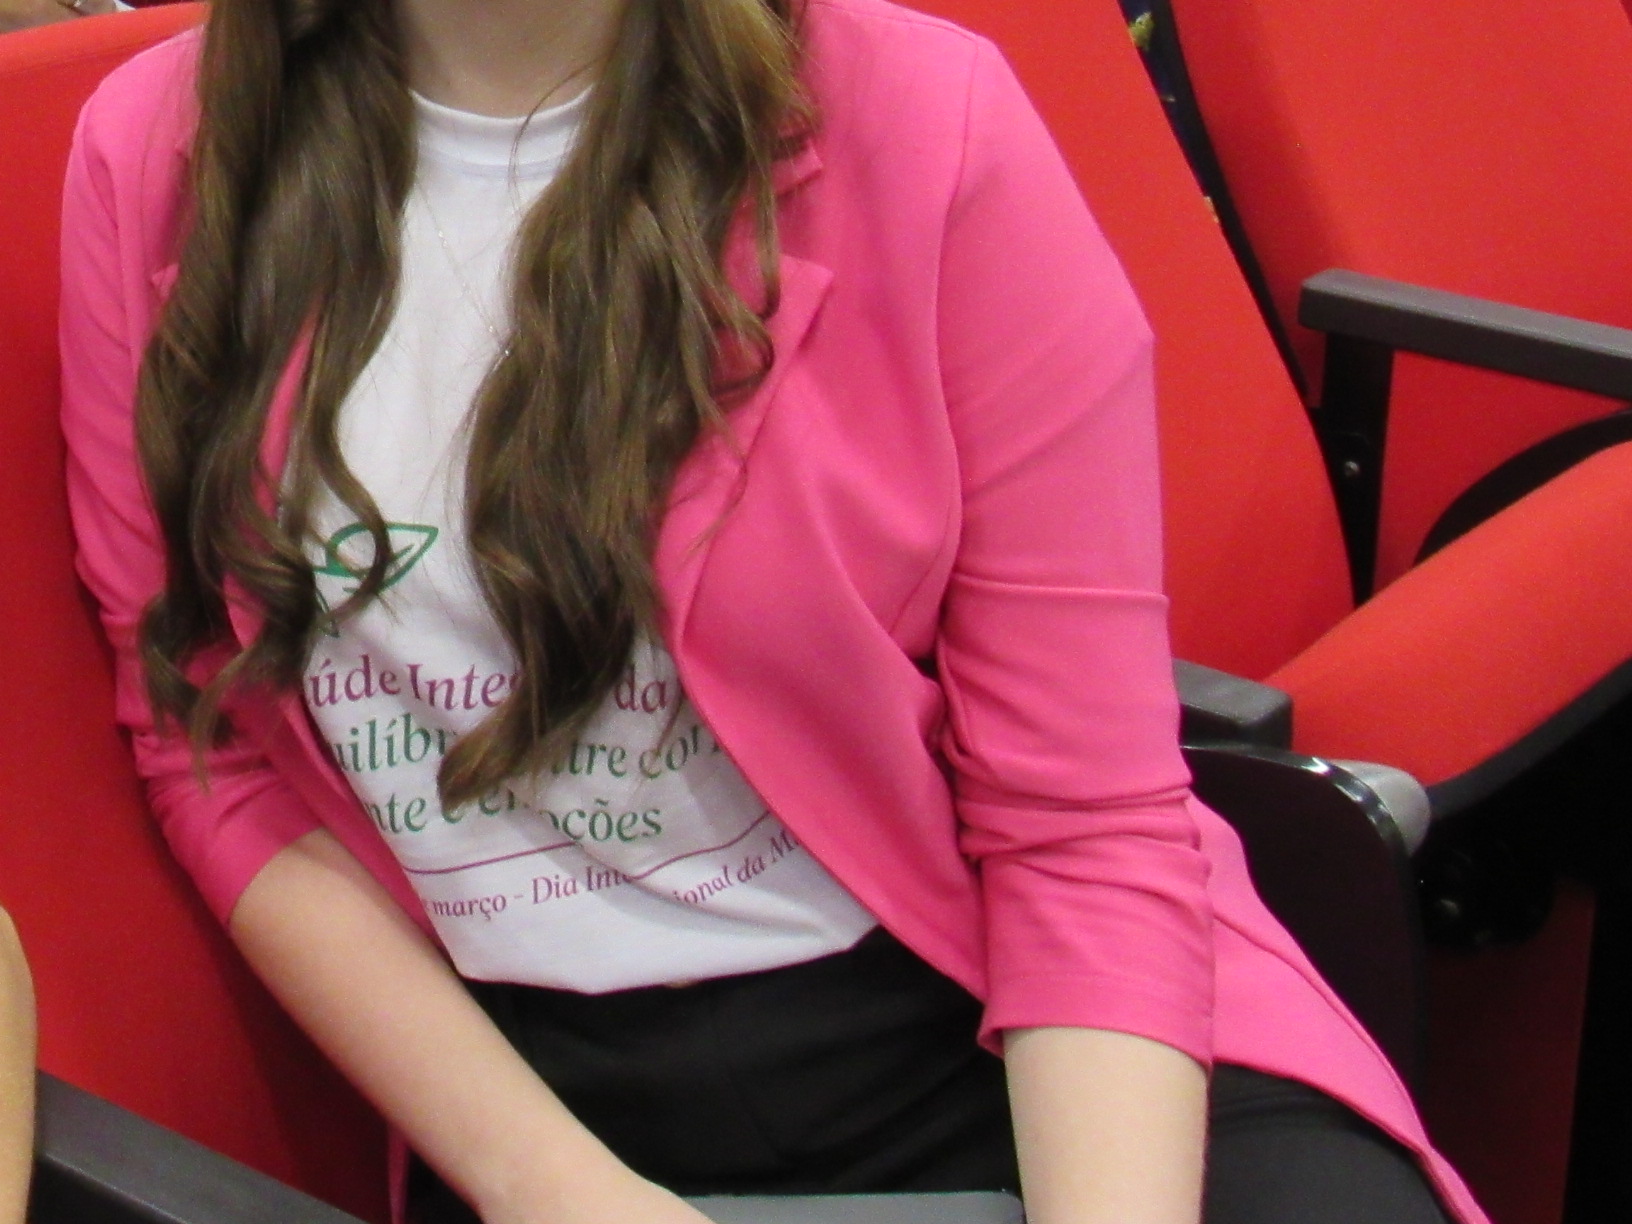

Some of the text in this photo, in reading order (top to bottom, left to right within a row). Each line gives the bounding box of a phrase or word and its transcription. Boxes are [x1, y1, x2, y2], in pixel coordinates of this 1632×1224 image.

[310, 653, 401, 708] úde
[431, 892, 508, 921] março
[532, 874, 579, 906] Dia
[736, 856, 766, 884] da
